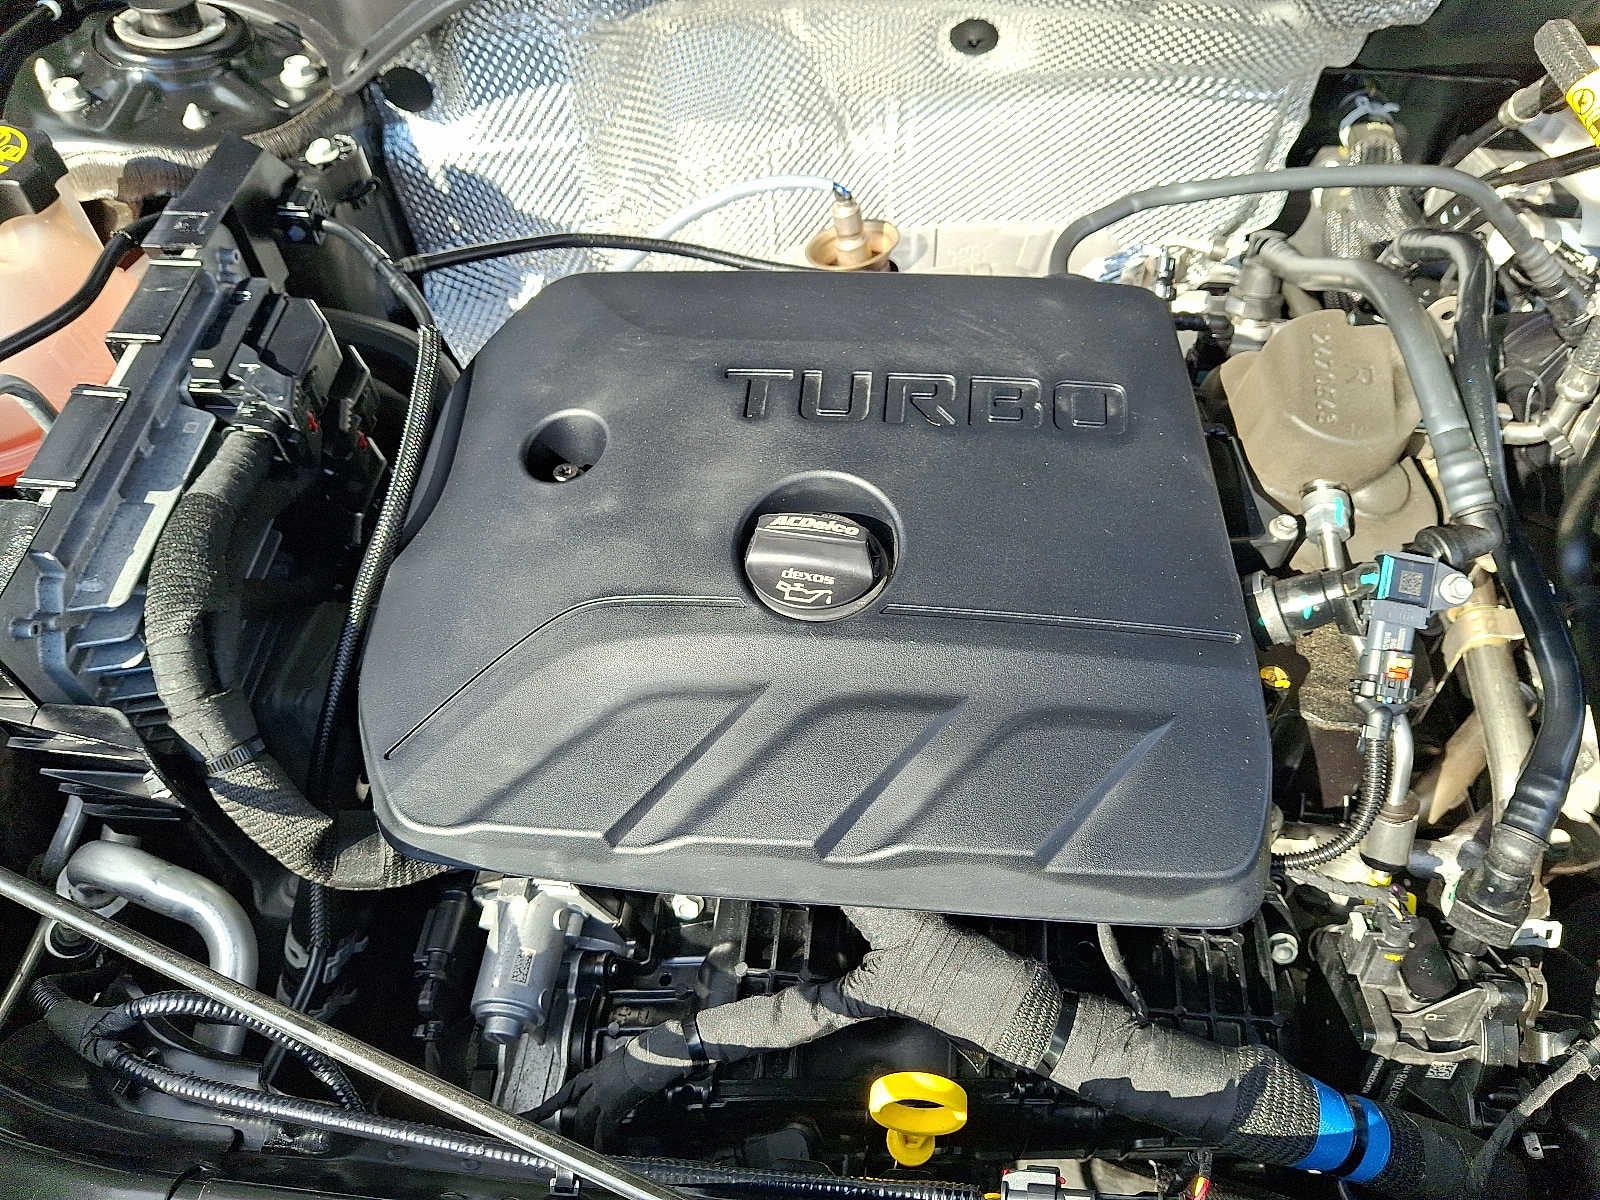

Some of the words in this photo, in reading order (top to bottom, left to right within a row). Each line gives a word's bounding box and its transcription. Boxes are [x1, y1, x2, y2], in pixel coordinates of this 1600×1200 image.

[724, 367, 1129, 436] TURBO
[767, 515, 860, 537] ACDelco
[781, 568, 835, 585] dexos
